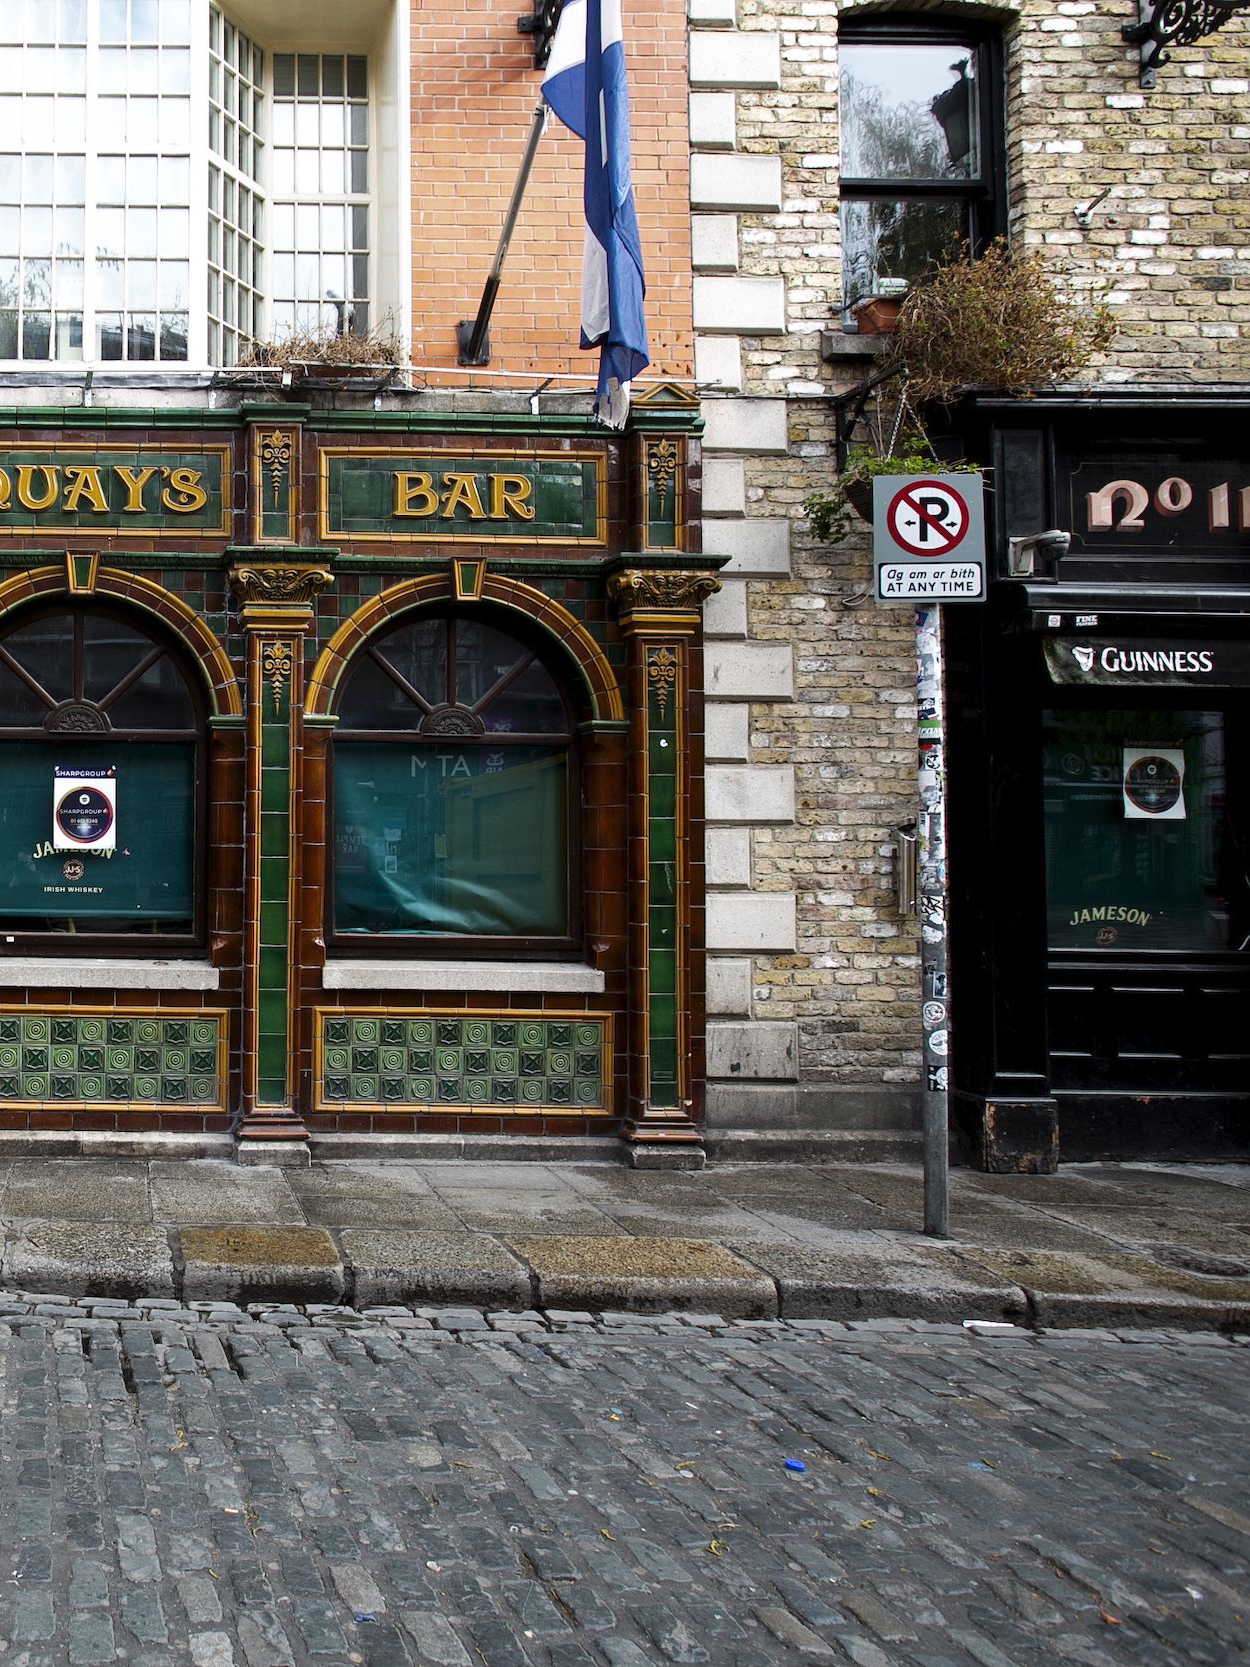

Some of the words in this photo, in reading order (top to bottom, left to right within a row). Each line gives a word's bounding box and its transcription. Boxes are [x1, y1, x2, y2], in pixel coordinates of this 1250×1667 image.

[392, 471, 535, 520] BAR
[887, 569, 904, 581] Ag
[909, 571, 927, 579] am
[933, 571, 946, 579] ar
[950, 568, 975, 579] bith
[887, 582, 904, 593] AT
[908, 582, 937, 592] ANY
[940, 581, 974, 592] TIME
[1101, 647, 1213, 672] GUINNESS
[1070, 906, 1150, 926] JAMESON
